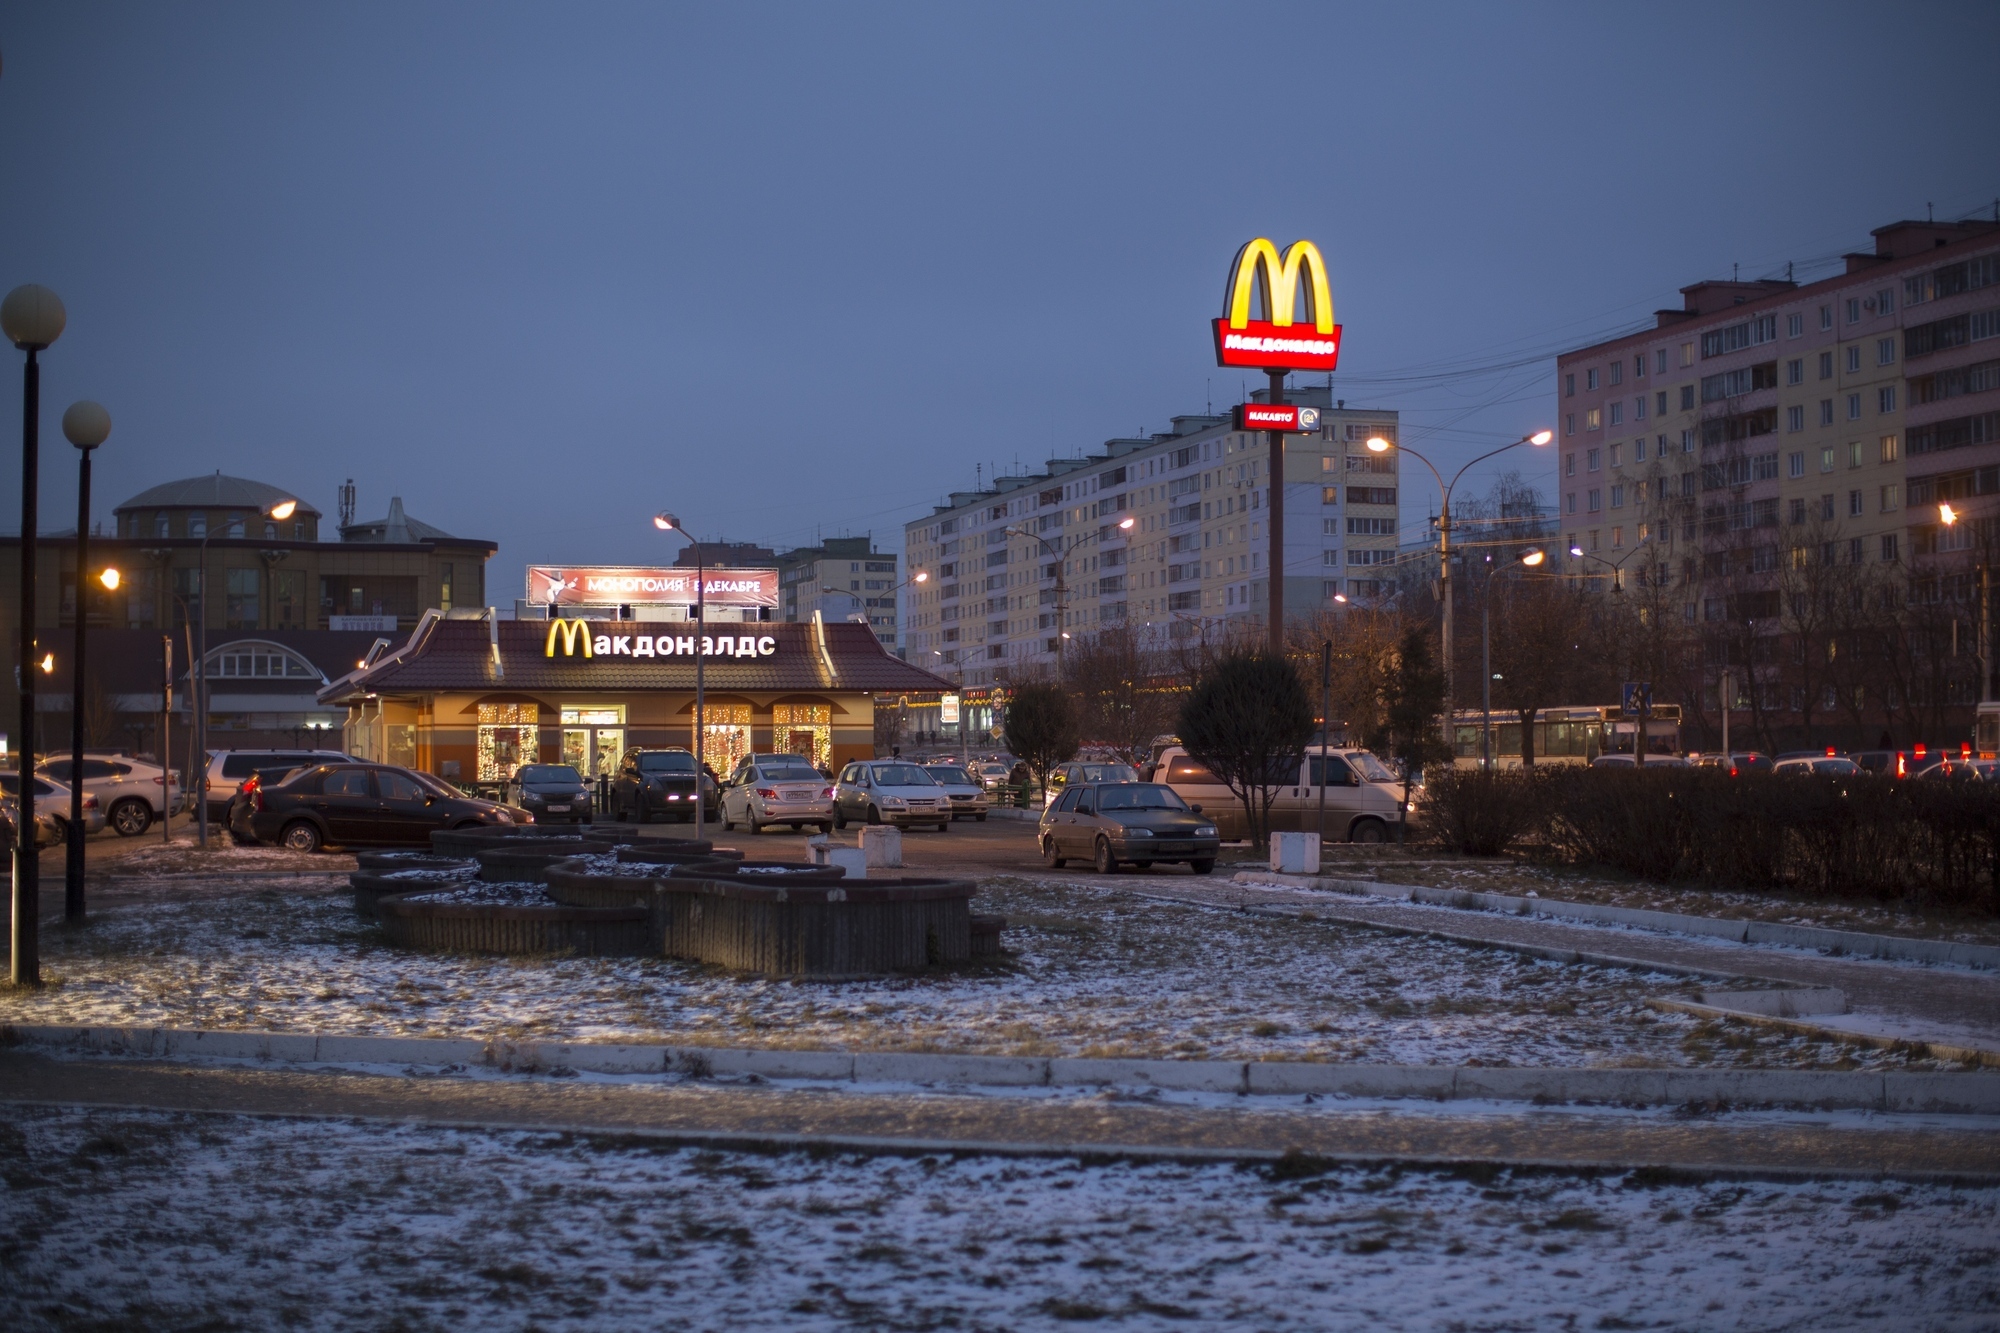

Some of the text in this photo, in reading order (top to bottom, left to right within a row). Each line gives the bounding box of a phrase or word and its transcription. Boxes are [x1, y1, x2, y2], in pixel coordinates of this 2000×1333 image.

[1225, 335, 1335, 354] Макдоналдс
[1249, 412, 1292, 422] МАКАВТО
[588, 578, 684, 592] МОНОПОЛИЯ
[704, 581, 761, 594] ДЕКАБРЕ
[546, 619, 775, 658] Макдоналдс
